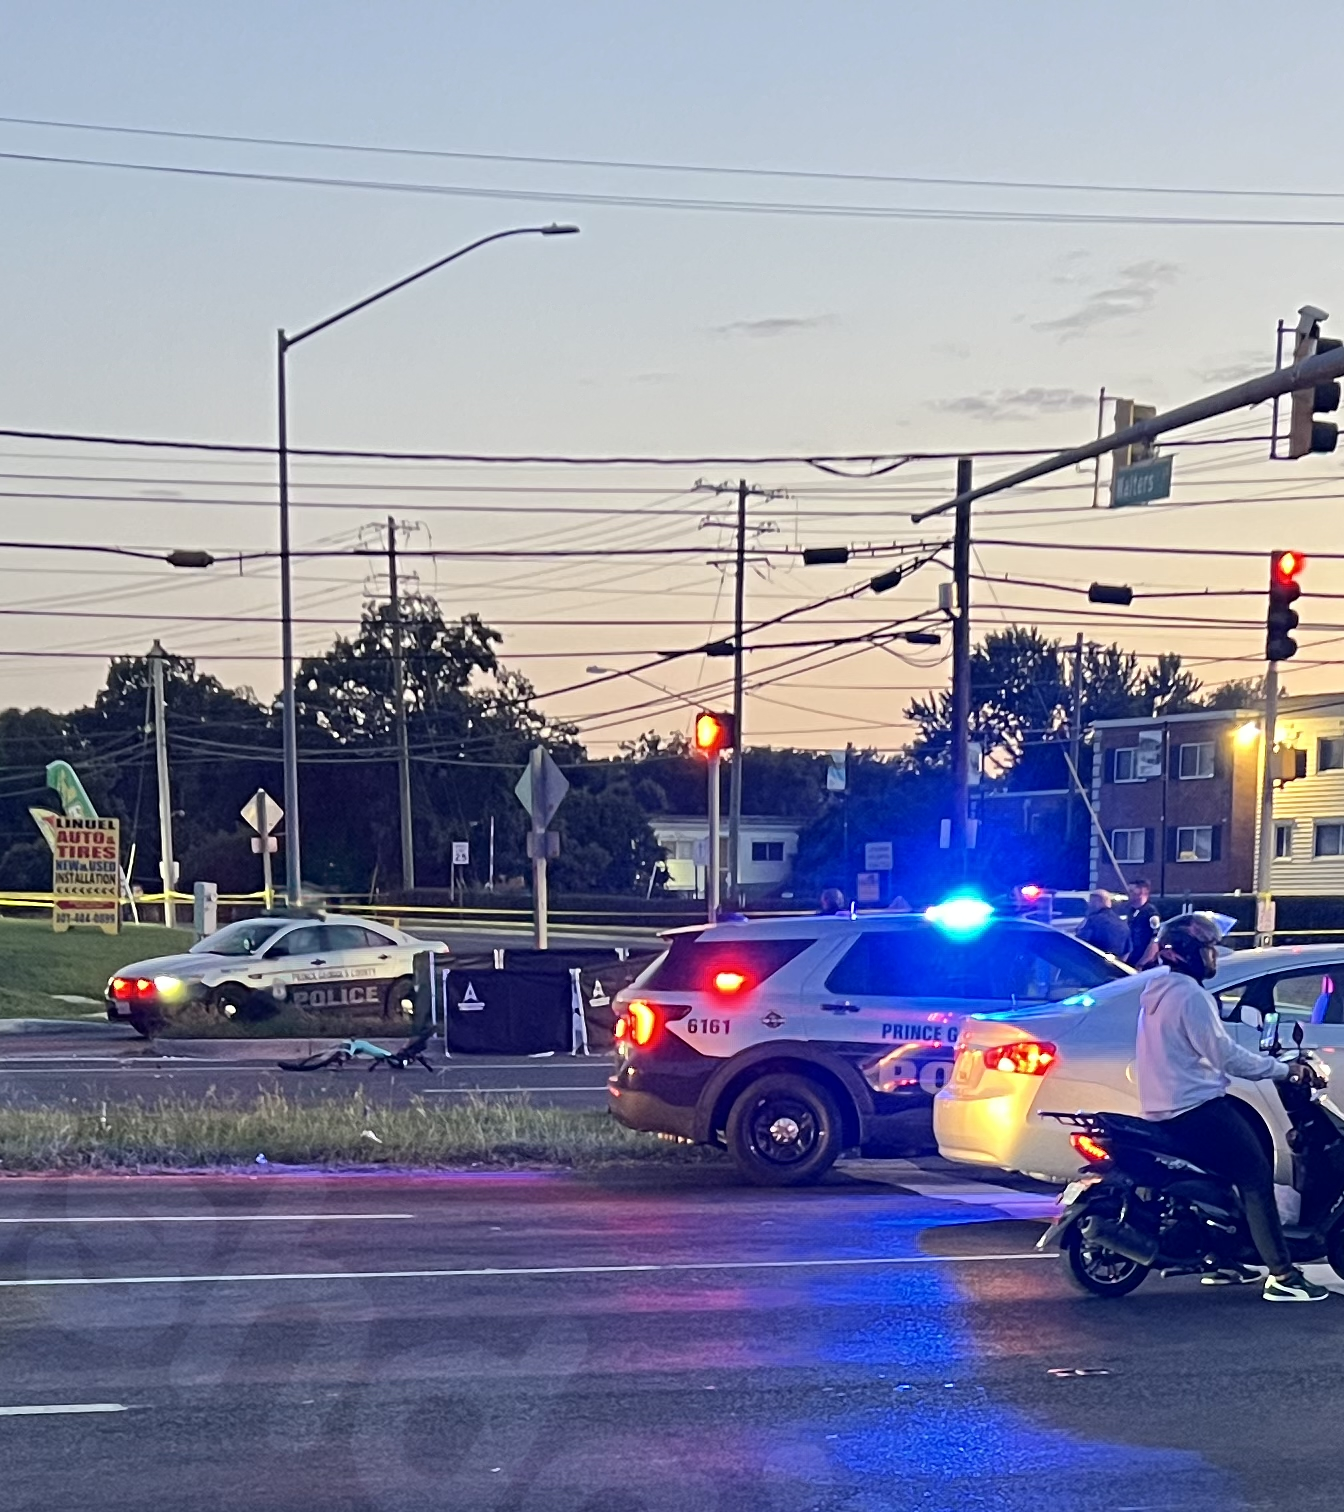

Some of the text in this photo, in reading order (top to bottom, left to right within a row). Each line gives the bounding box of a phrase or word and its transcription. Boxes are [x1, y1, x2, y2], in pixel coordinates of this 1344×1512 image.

[57, 819, 116, 830] LINUEL
[57, 846, 116, 859] TIRES
[57, 873, 116, 884] INSTALLATION
[293, 986, 381, 1007] POLICE
[687, 1018, 731, 1034] 6161
[881, 1023, 943, 1041] PRINCE
